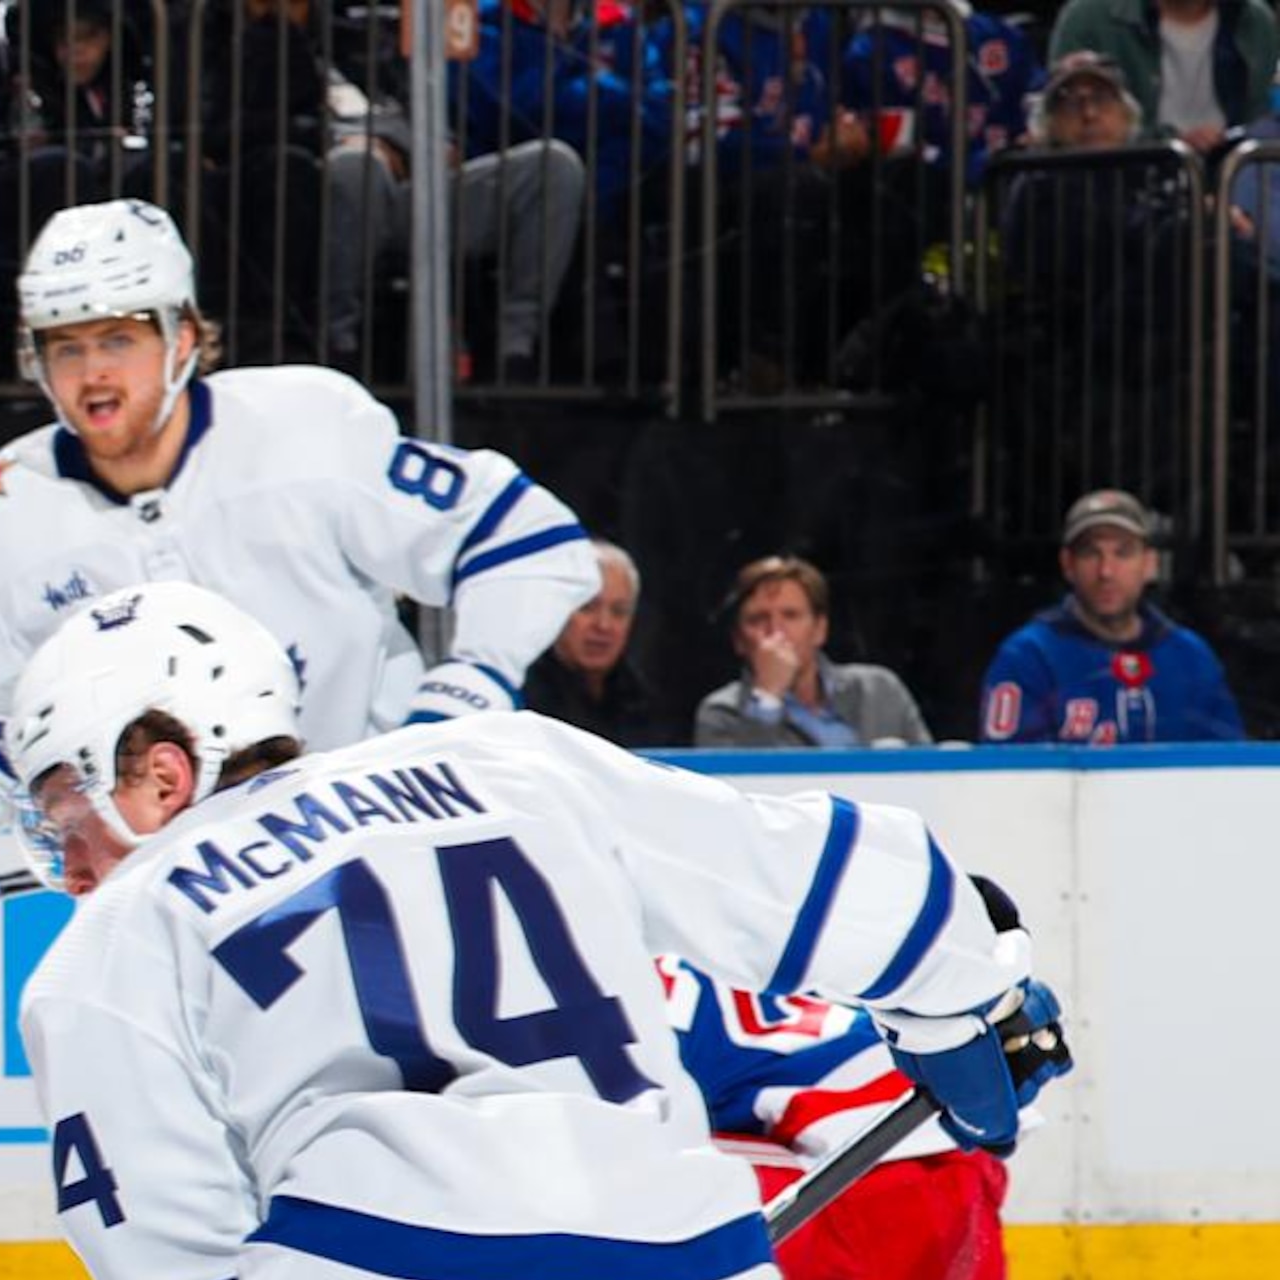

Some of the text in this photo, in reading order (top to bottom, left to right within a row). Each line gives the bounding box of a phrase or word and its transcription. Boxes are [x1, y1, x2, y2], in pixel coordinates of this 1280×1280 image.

[167, 761, 490, 915] McMANN
[210, 835, 663, 1105] 74
[52, 1110, 128, 1230] 4
